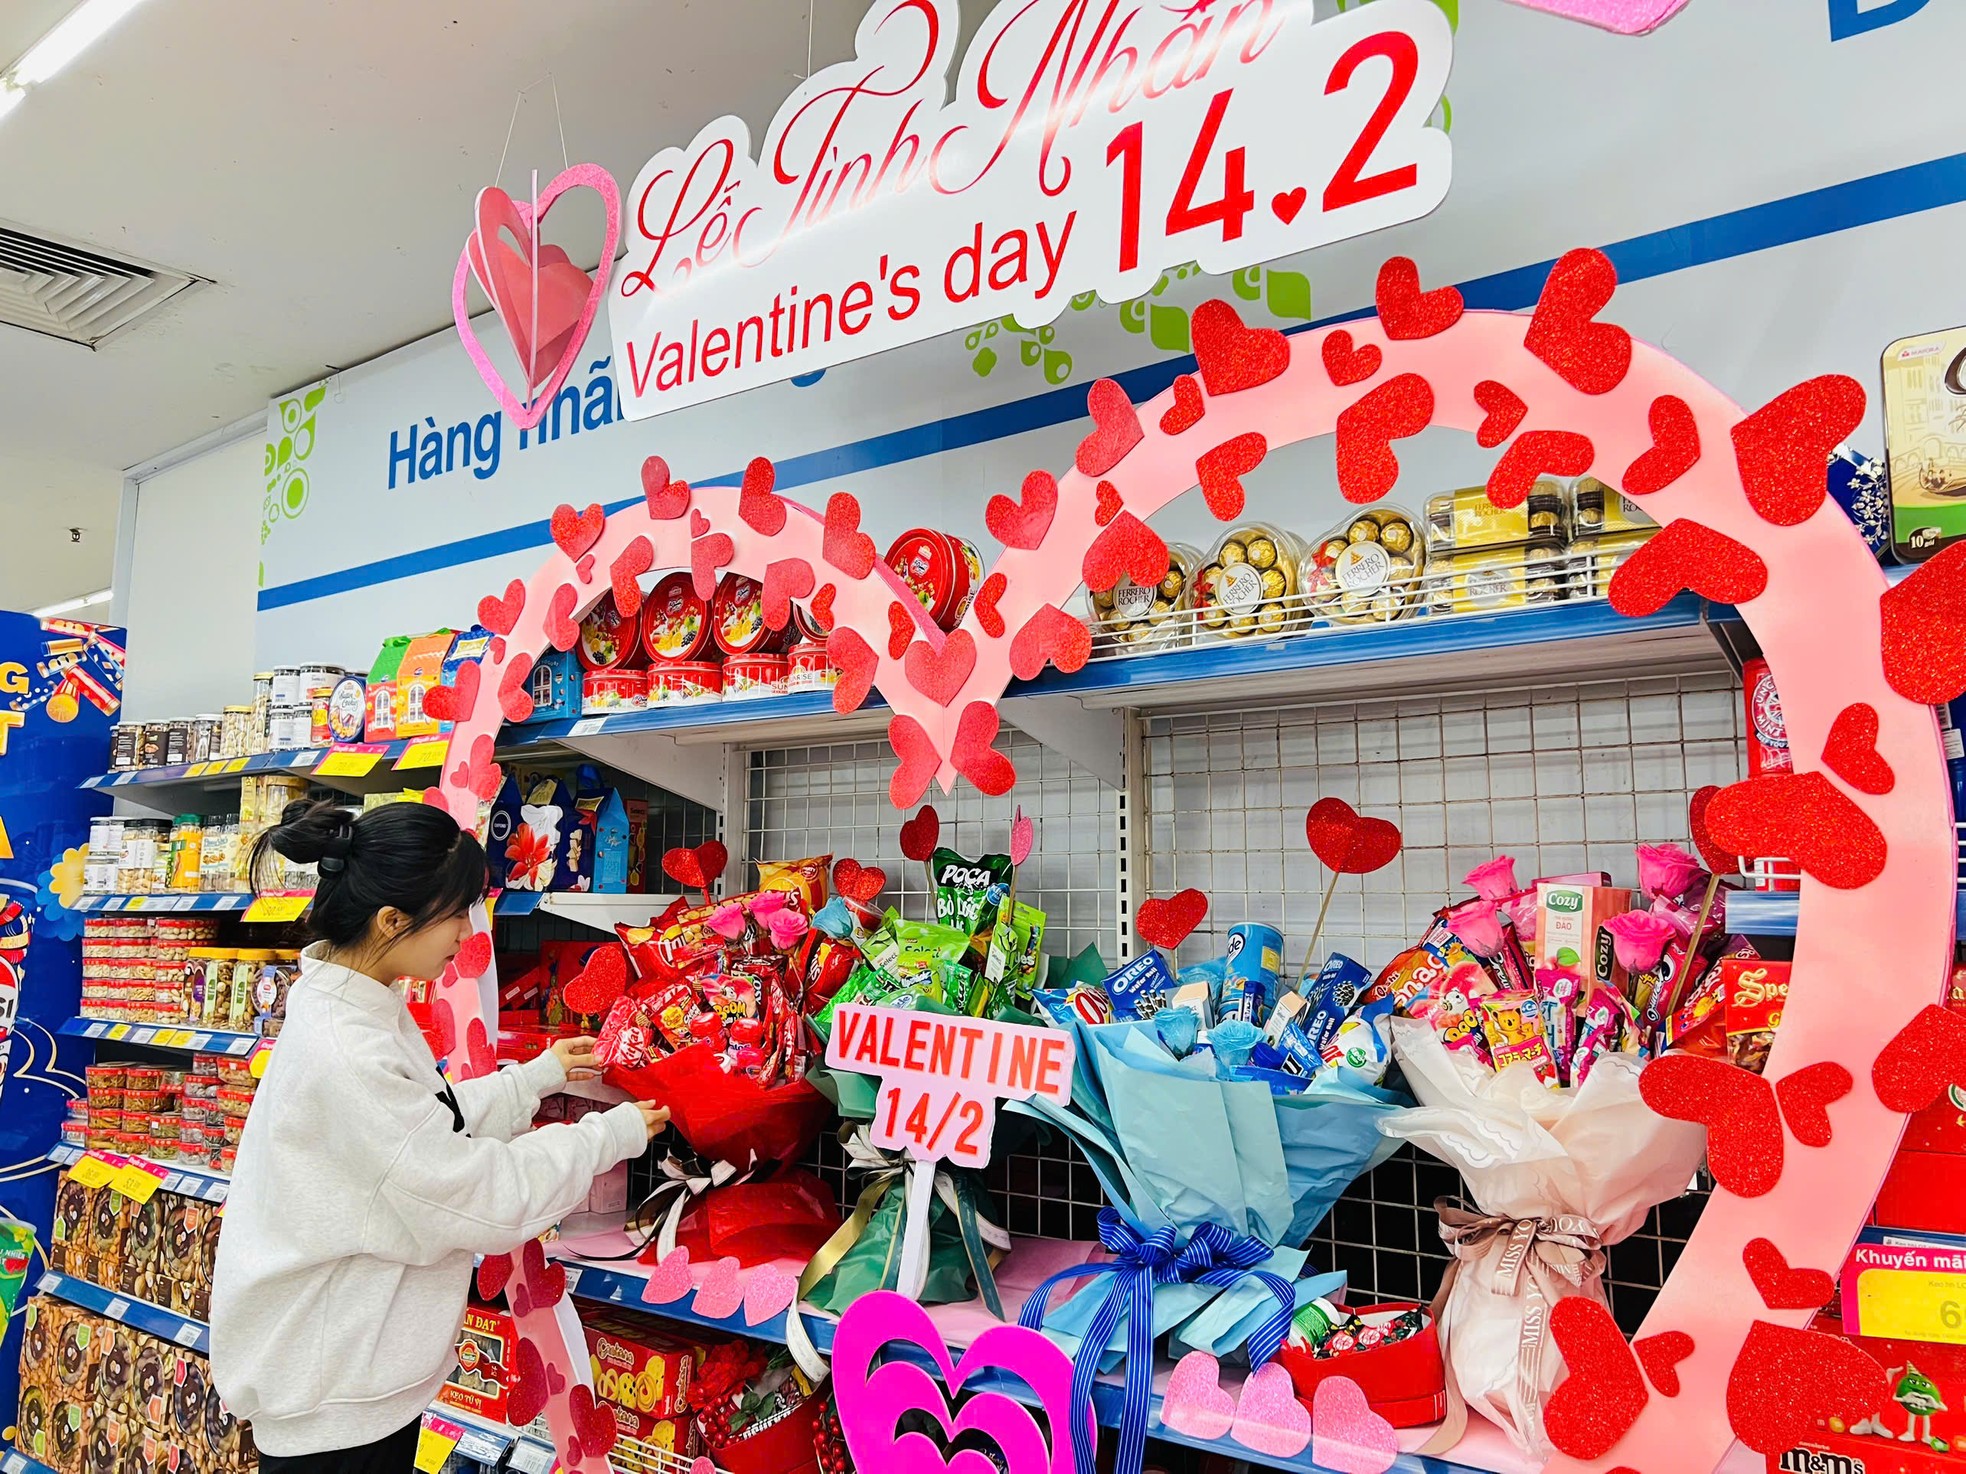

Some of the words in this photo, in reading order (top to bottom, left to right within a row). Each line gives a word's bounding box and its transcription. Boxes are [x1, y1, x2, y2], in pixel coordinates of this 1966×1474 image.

[626, 253, 921, 399] Valentine's
[943, 210, 1078, 312] day
[387, 410, 502, 490] Hàng
[1910, 535, 1924, 549] 10
[1342, 553, 1380, 584] FERRERO
[1118, 586, 1151, 598] FERRERO
[1118, 595, 1150, 606] ROCHER
[1223, 572, 1251, 605] FERRERO
[940, 864, 991, 887] POCA
[937, 894, 954, 919] BÒ
[1548, 893, 1579, 909] Cozy
[1597, 933, 1612, 977] Cozy
[1113, 957, 1154, 994] OREO
[838, 1010, 1065, 1094] VALENTINE
[884, 1087, 984, 1156] 14/2
[1497, 1243, 1524, 1277] MISS
[1855, 1249, 1928, 1269] Khuyến
